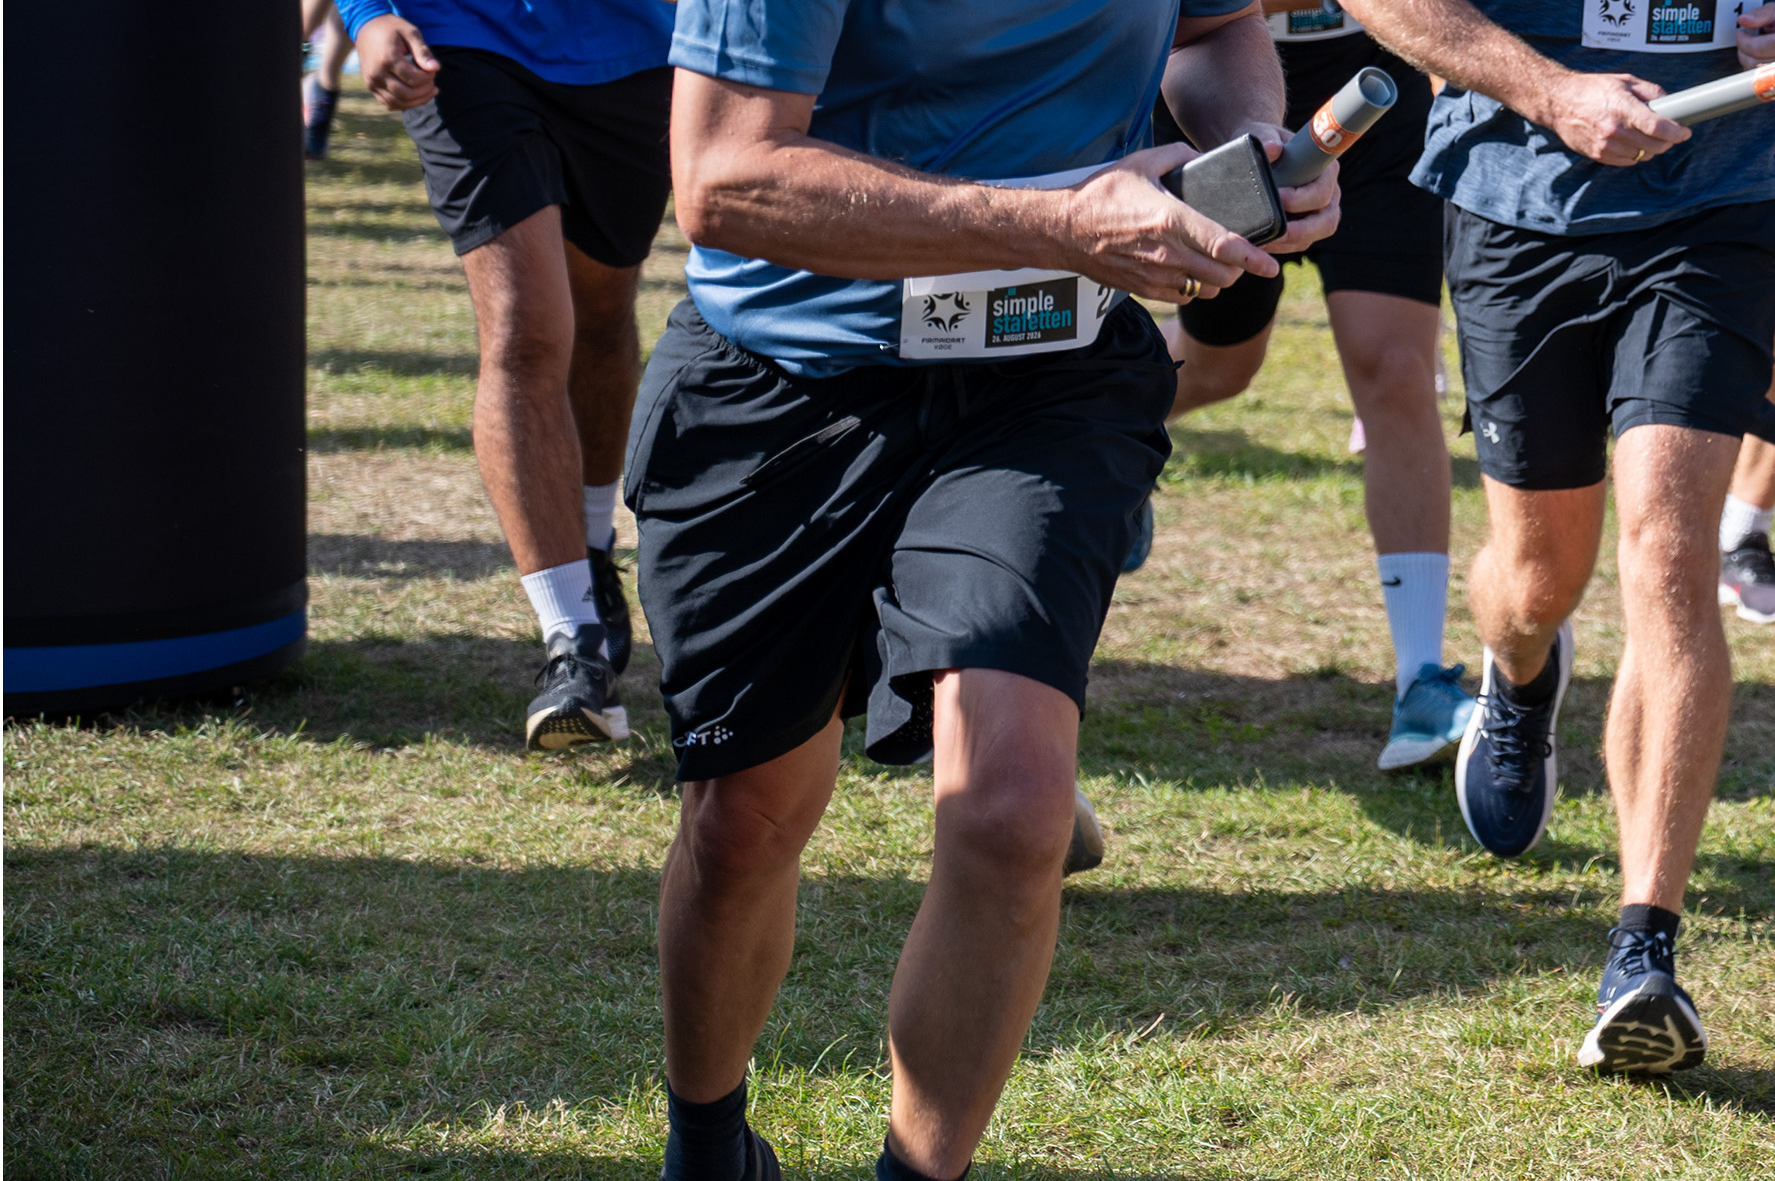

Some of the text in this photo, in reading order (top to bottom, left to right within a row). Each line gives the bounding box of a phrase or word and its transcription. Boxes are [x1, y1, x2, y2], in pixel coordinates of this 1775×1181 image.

[1652, 0, 1700, 26] simple
[1651, 17, 1712, 36] stafetten
[1313, 111, 1343, 148] 30
[993, 288, 1054, 320] simple
[993, 309, 1072, 334] stafetten
[1003, 332, 1026, 342] AUGUST
[1026, 331, 1042, 340] 2026
